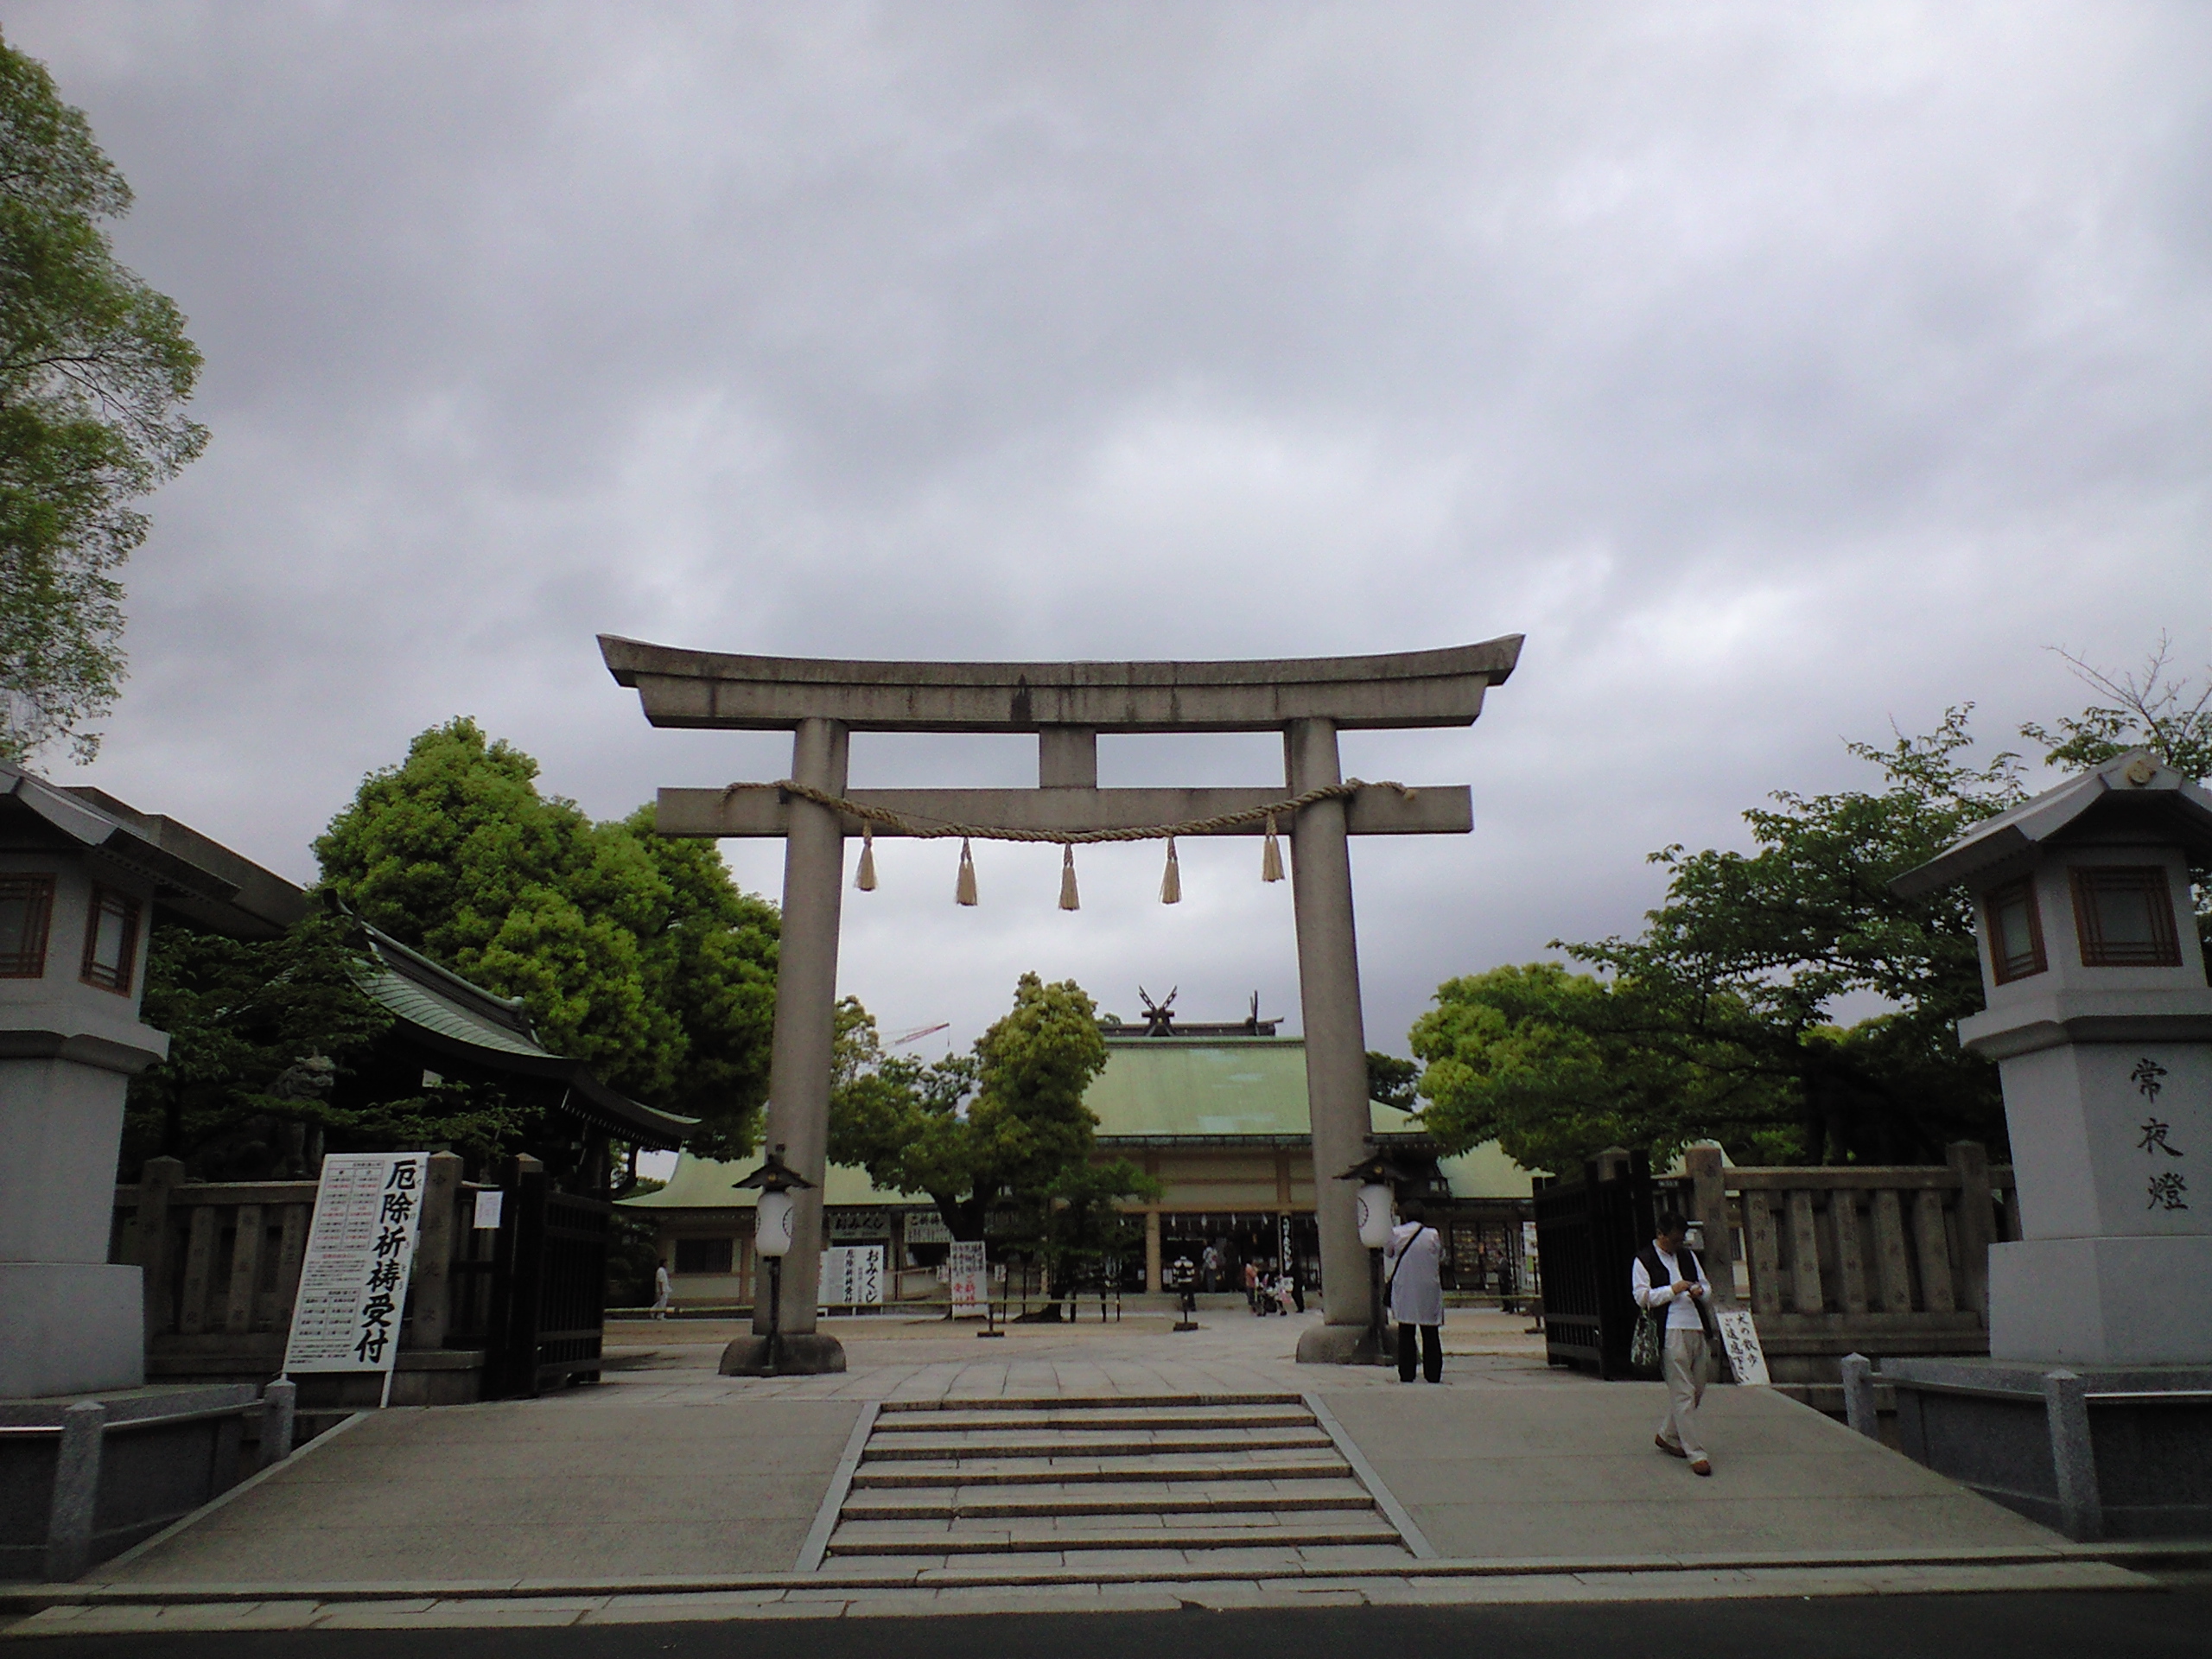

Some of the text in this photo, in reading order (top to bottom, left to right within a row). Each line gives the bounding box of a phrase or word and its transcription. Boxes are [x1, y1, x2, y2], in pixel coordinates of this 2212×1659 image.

[2131, 1058, 2189, 1211] 常夜燈
[354, 1159, 417, 1363] 厄除祈祷受付
[865, 1249, 879, 1303] おみくじ
[1736, 1313, 1758, 1368] 犬の散歩
